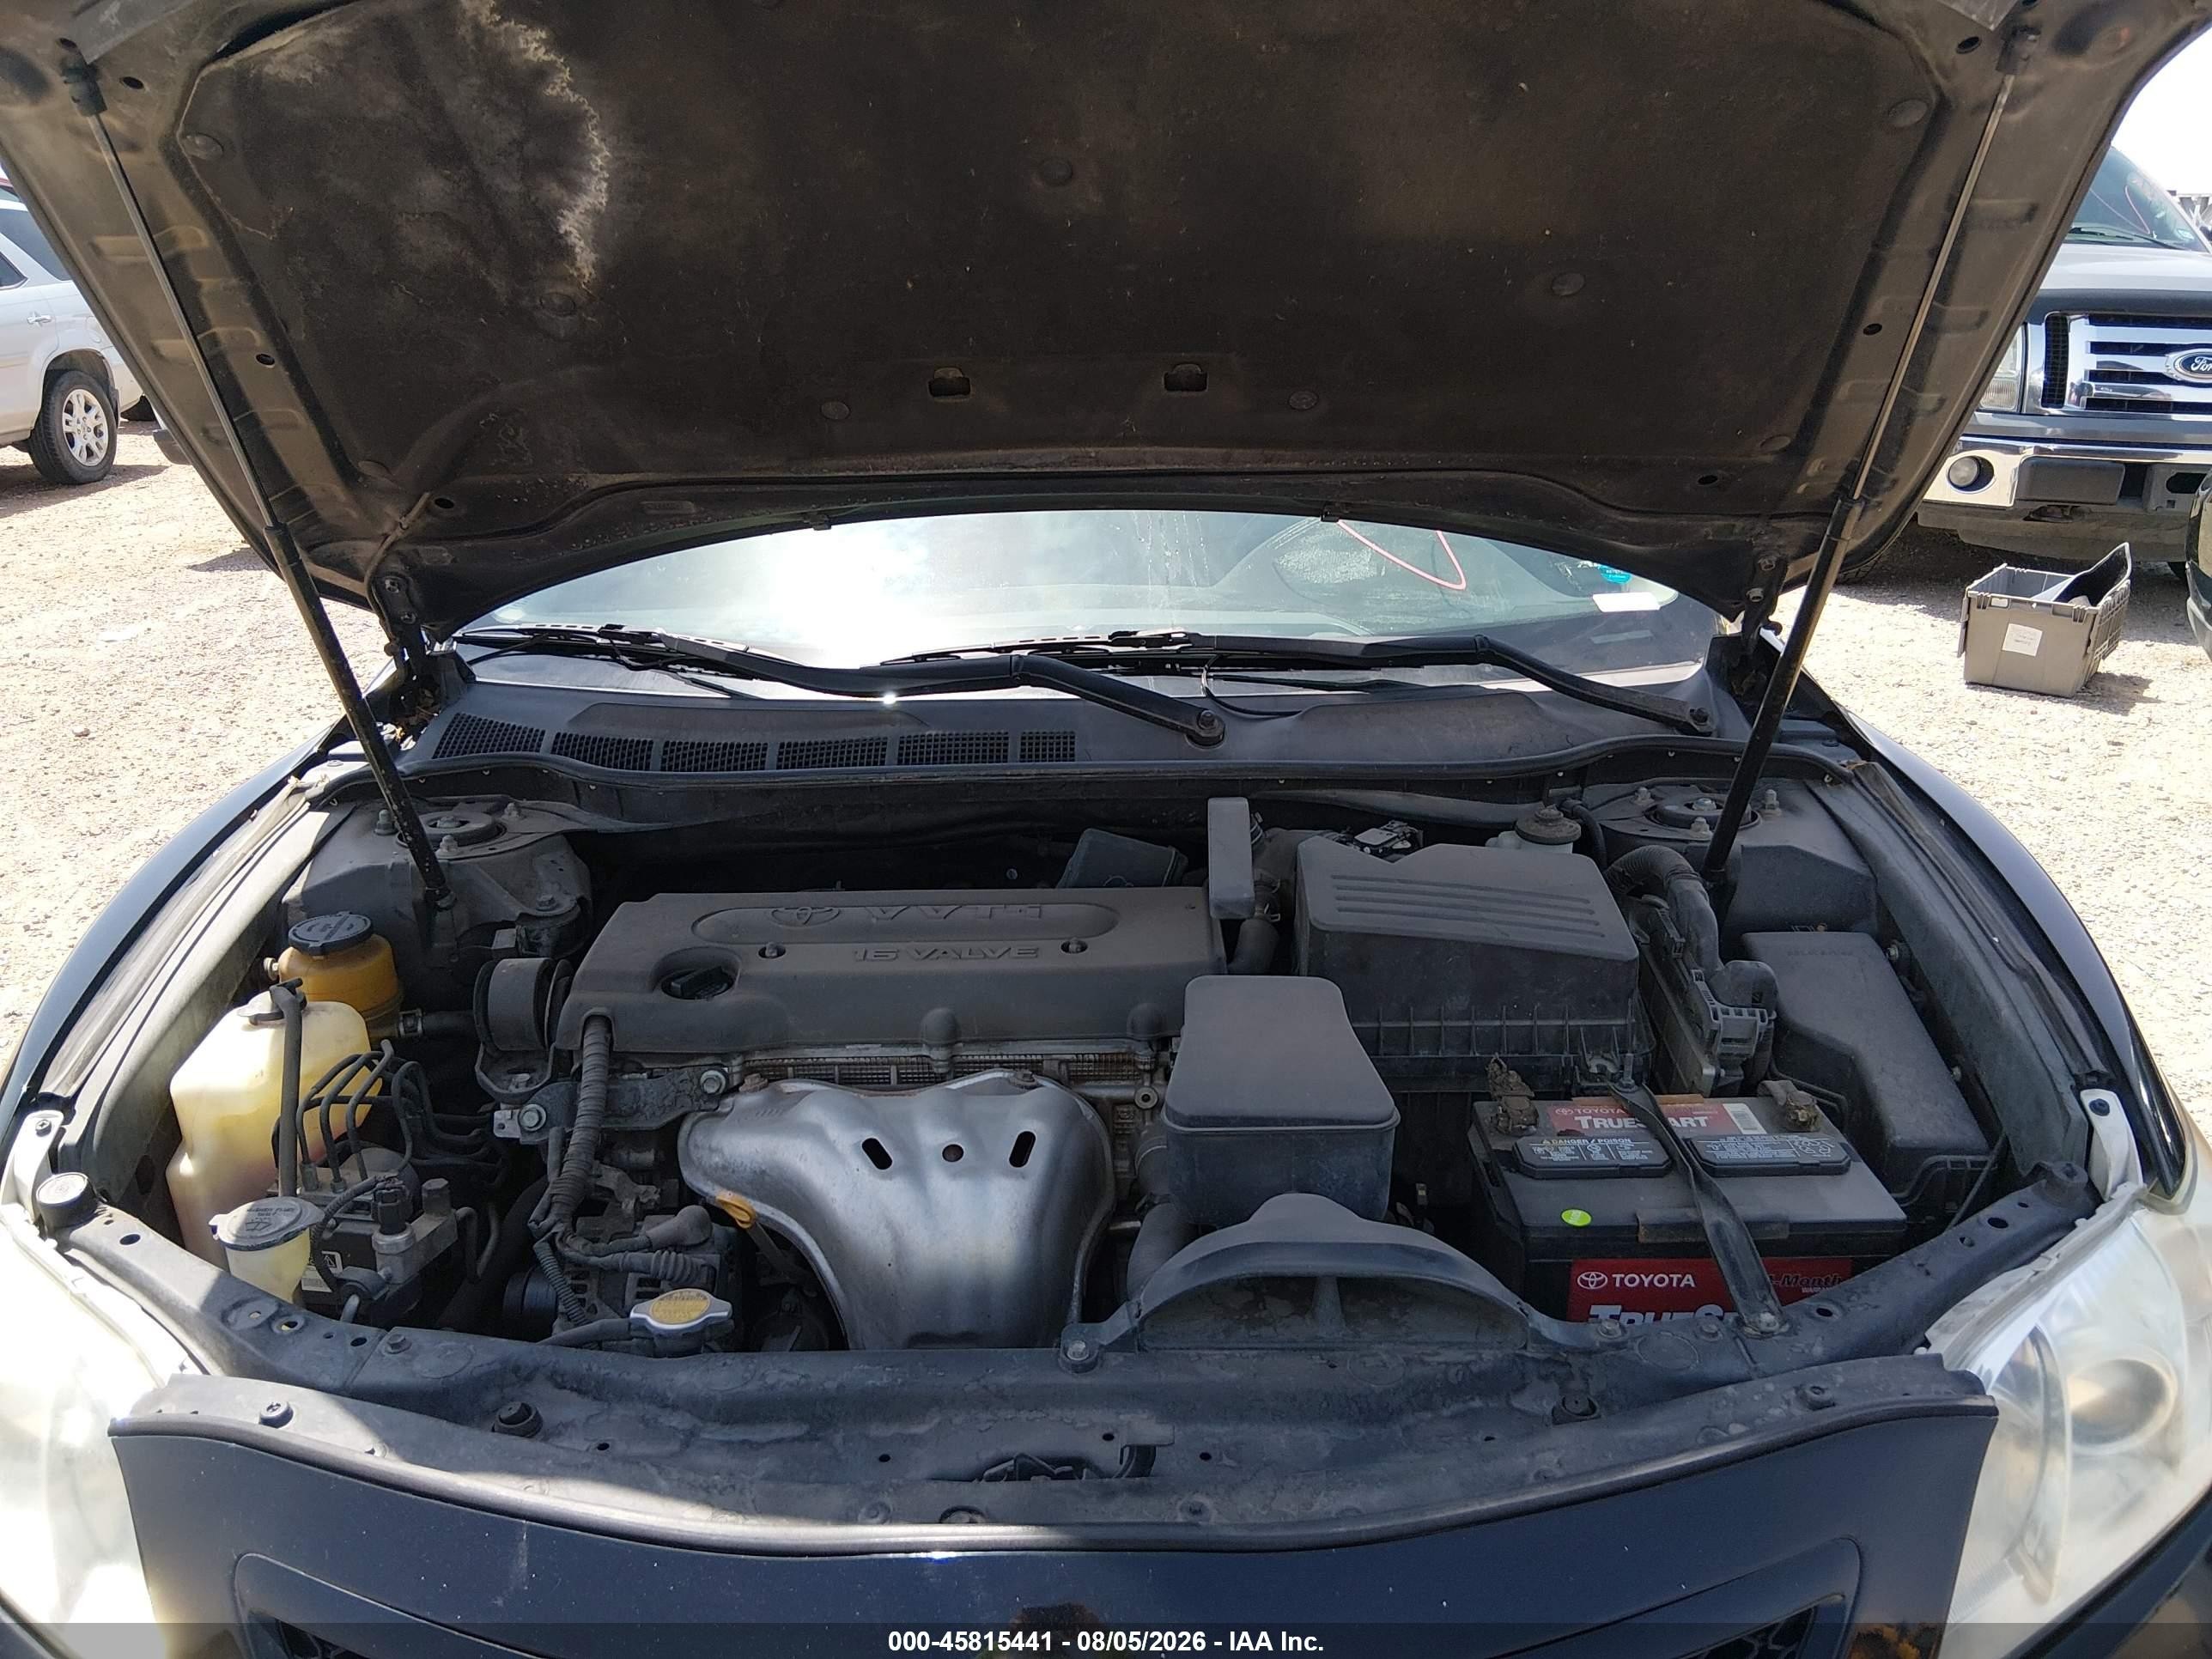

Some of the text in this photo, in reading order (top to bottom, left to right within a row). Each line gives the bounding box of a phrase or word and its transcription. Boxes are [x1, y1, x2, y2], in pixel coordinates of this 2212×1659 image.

[2191, 356, 2212, 372] For
[854, 946, 1039, 962] 16 VALVE
[1612, 1273, 1696, 1288] TOYOTA
